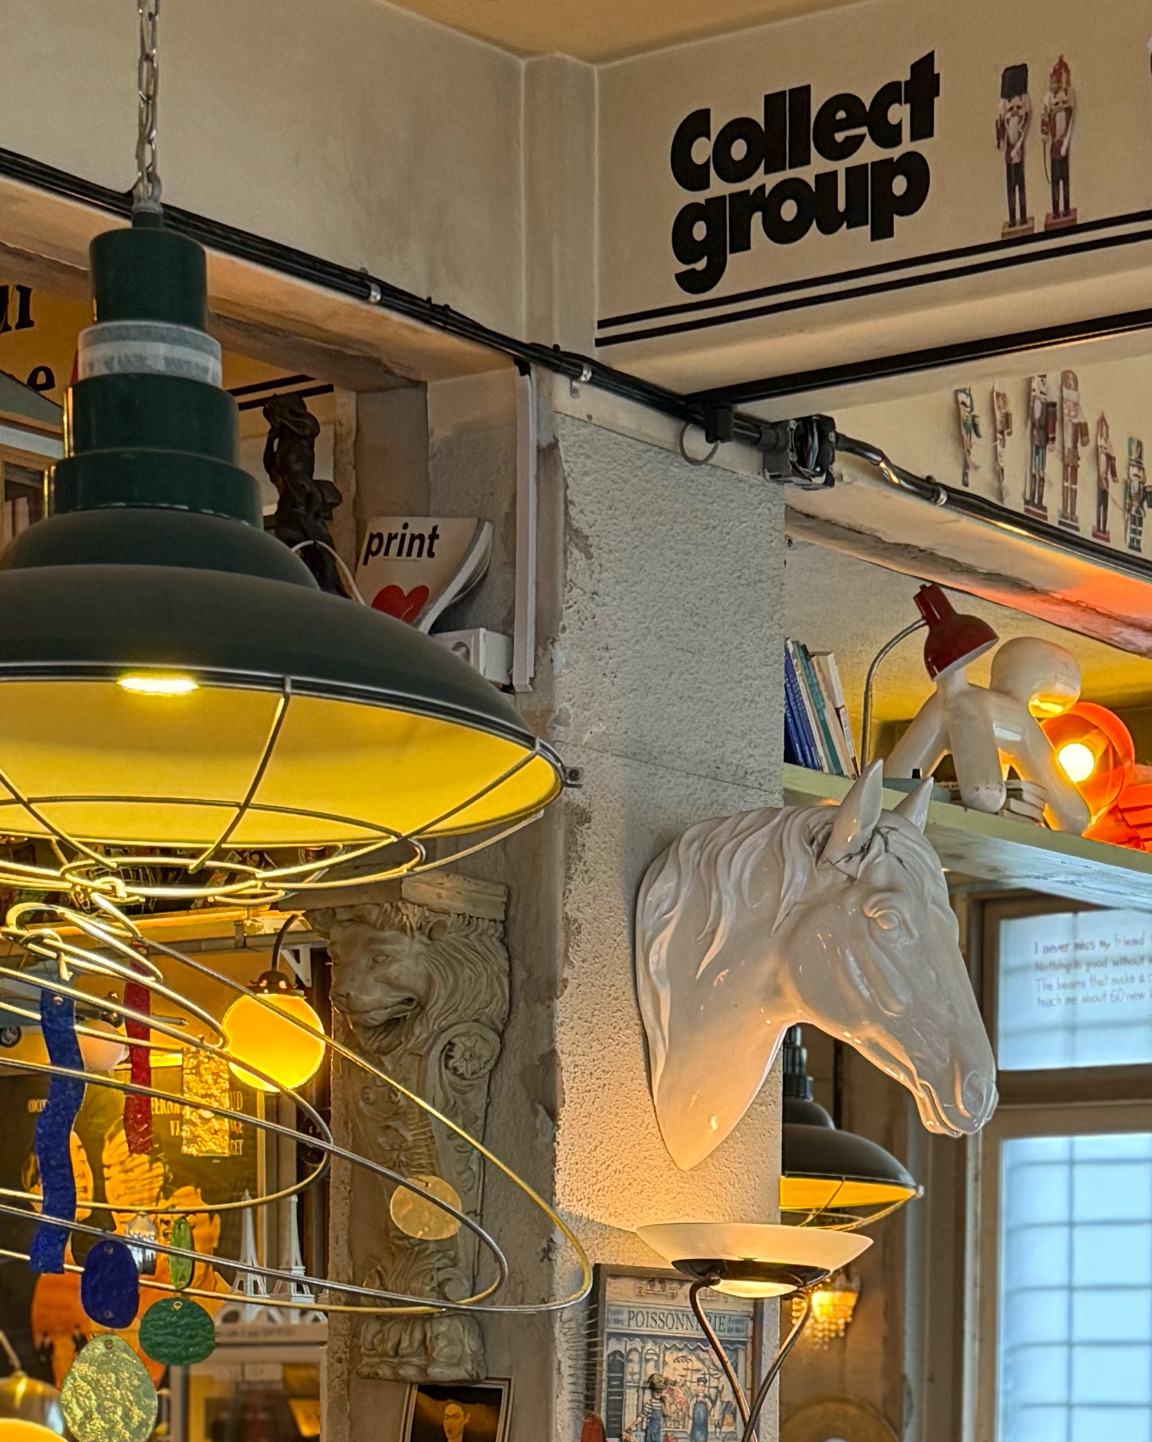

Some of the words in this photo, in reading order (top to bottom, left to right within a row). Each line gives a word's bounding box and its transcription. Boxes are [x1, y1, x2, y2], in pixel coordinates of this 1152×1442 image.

[672, 151, 930, 294] group
[363, 522, 439, 566] print
[1043, 942, 1071, 955] never
[1074, 938, 1096, 952] miss
[1115, 929, 1145, 948] friend
[1034, 978, 1053, 993] The
[1057, 975, 1086, 990] beans
[1112, 971, 1136, 986] make
[1037, 993, 1062, 1008] teach
[1065, 995, 1078, 1006] me
[1081, 989, 1107, 1004] about
[1110, 988, 1125, 1003] 60
